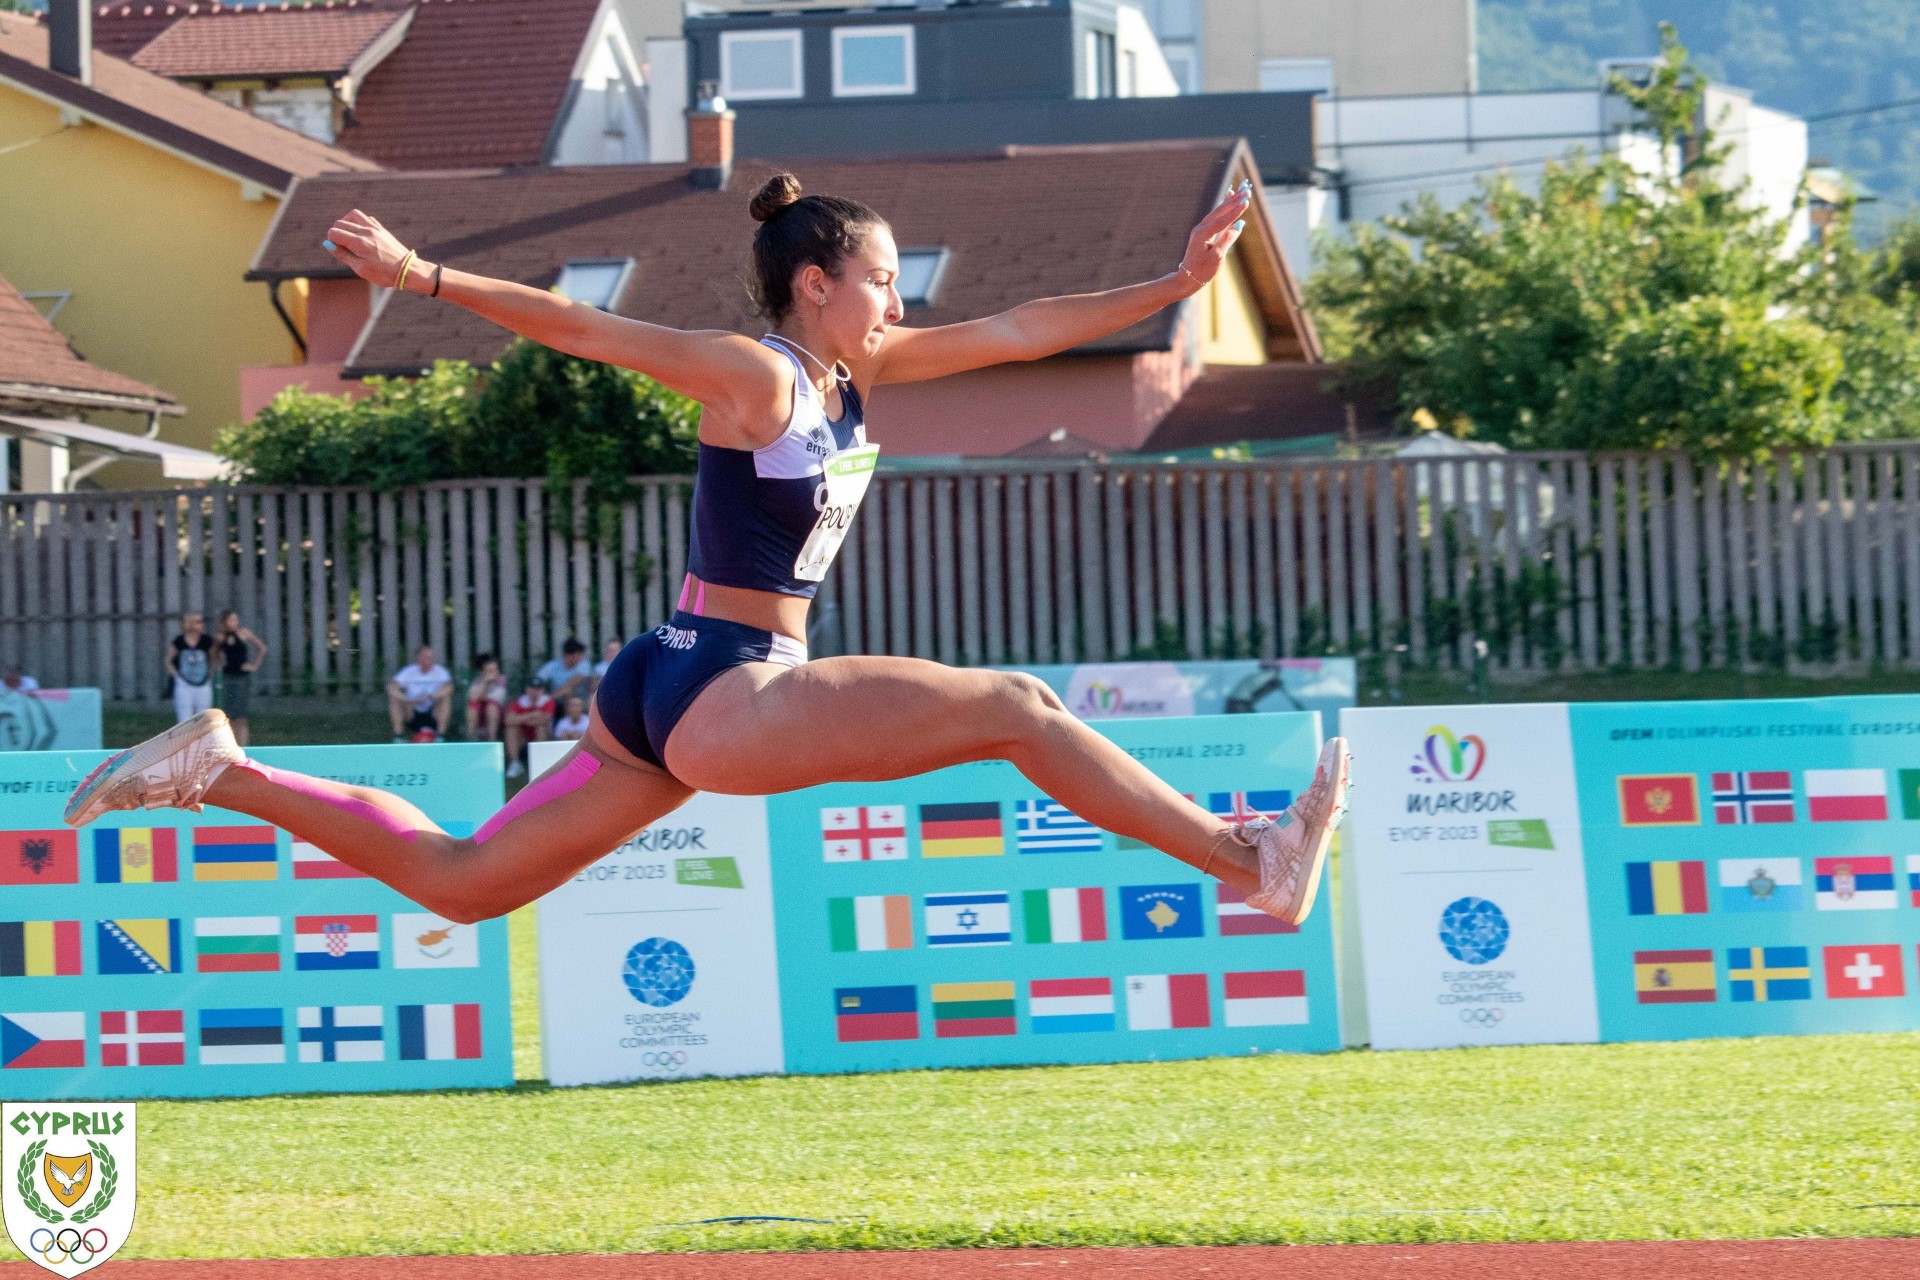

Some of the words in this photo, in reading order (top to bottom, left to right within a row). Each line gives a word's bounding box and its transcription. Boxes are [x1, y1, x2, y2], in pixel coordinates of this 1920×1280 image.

[655, 624, 698, 650] CYPRUS
[1767, 722, 1843, 737] FESTIVAL
[1122, 746, 1194, 760] ESTIVAL
[1201, 743, 1245, 758] 2023
[384, 773, 429, 787] 2023
[0, 781, 33, 794] YOF
[1407, 790, 1518, 816] MARIBOR
[615, 827, 707, 854] ARIBOR
[1389, 826, 1432, 842] EYOF
[1438, 825, 1479, 841] 2023
[623, 864, 667, 880] 2023
[1441, 970, 1517, 982] EUROPEAN
[1450, 981, 1510, 993] OLYMPIC
[1438, 991, 1524, 1005] COMMITTEES
[624, 1012, 701, 1025] EUROPEAN
[634, 1023, 693, 1036] OLYMPIC
[619, 1034, 708, 1048] COMMITTEES
